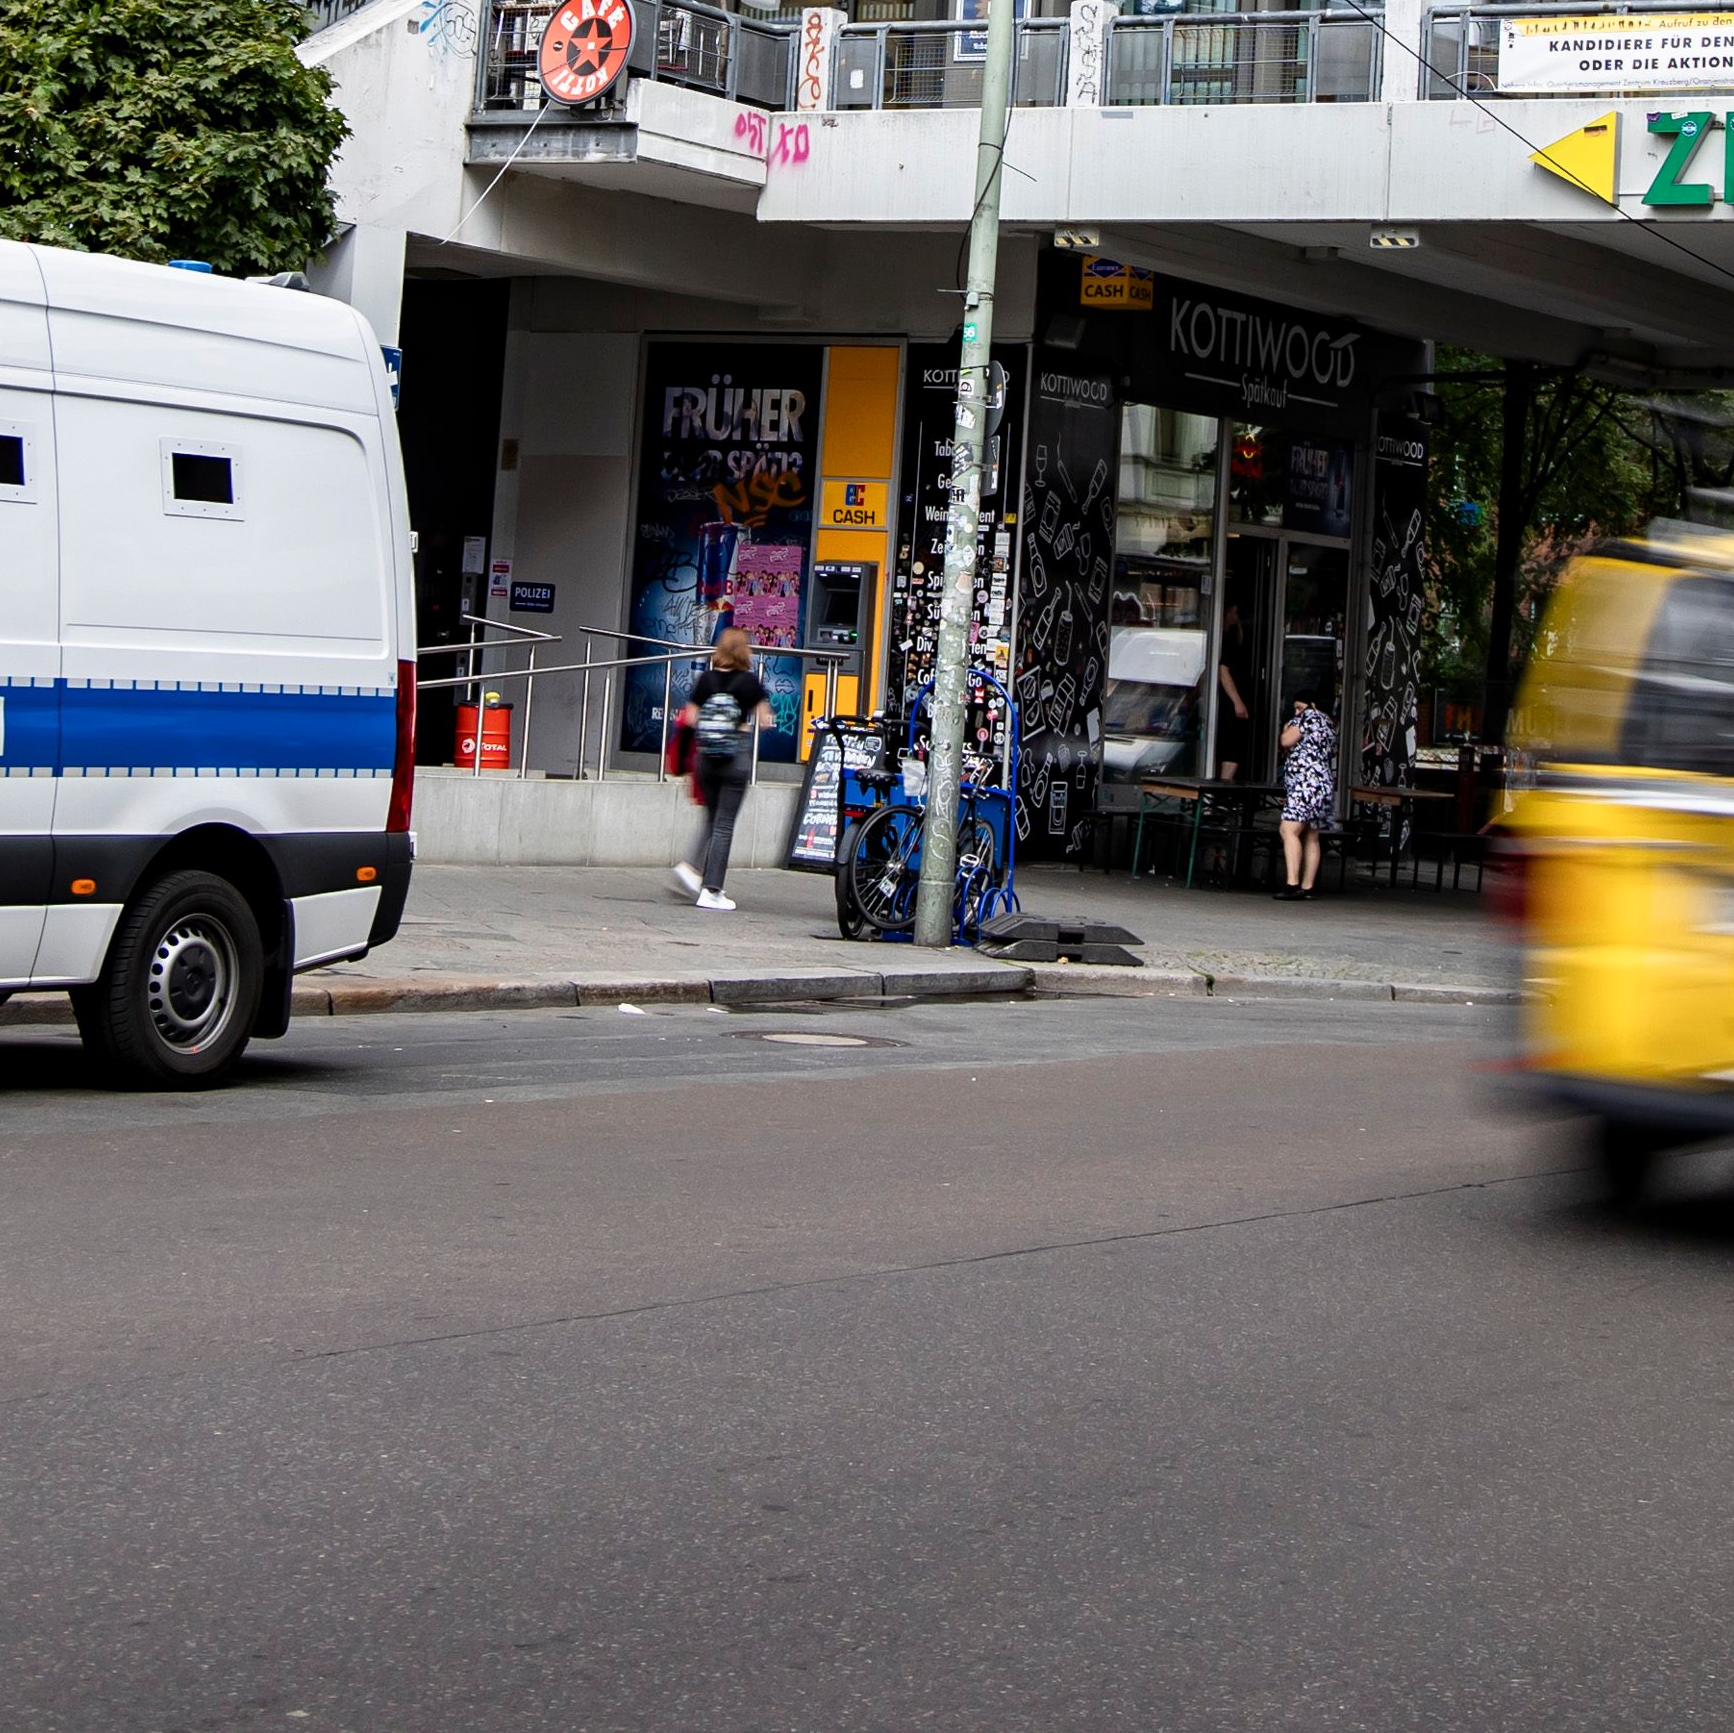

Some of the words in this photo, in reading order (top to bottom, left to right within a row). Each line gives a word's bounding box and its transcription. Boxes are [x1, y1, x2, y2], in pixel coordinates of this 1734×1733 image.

[1659, 17, 1693, 28] Aufruf
[1713, 16, 1732, 26] den
[1549, 38, 1652, 52] KANDIDIERE
[1661, 35, 1692, 49] FÜR
[1701, 35, 1734, 48] DEN
[1579, 59, 1623, 71] ODER
[1632, 58, 1659, 70] DIE
[551, 67, 608, 95] KOTTI
[1085, 284, 1124, 297] CASH
[1170, 297, 1357, 388] KOTTIWOOD
[923, 369, 1010, 383] KOTTD
[1040, 372, 1108, 401] KOTTIWOOD
[1242, 372, 1288, 409] Spätkauf
[662, 373, 806, 442] FRÜHER
[1378, 436, 1424, 459] OTTIWOOD
[833, 509, 875, 525] CASH
[515, 586, 551, 599] POLIZEI
[968, 672, 982, 687] Go
